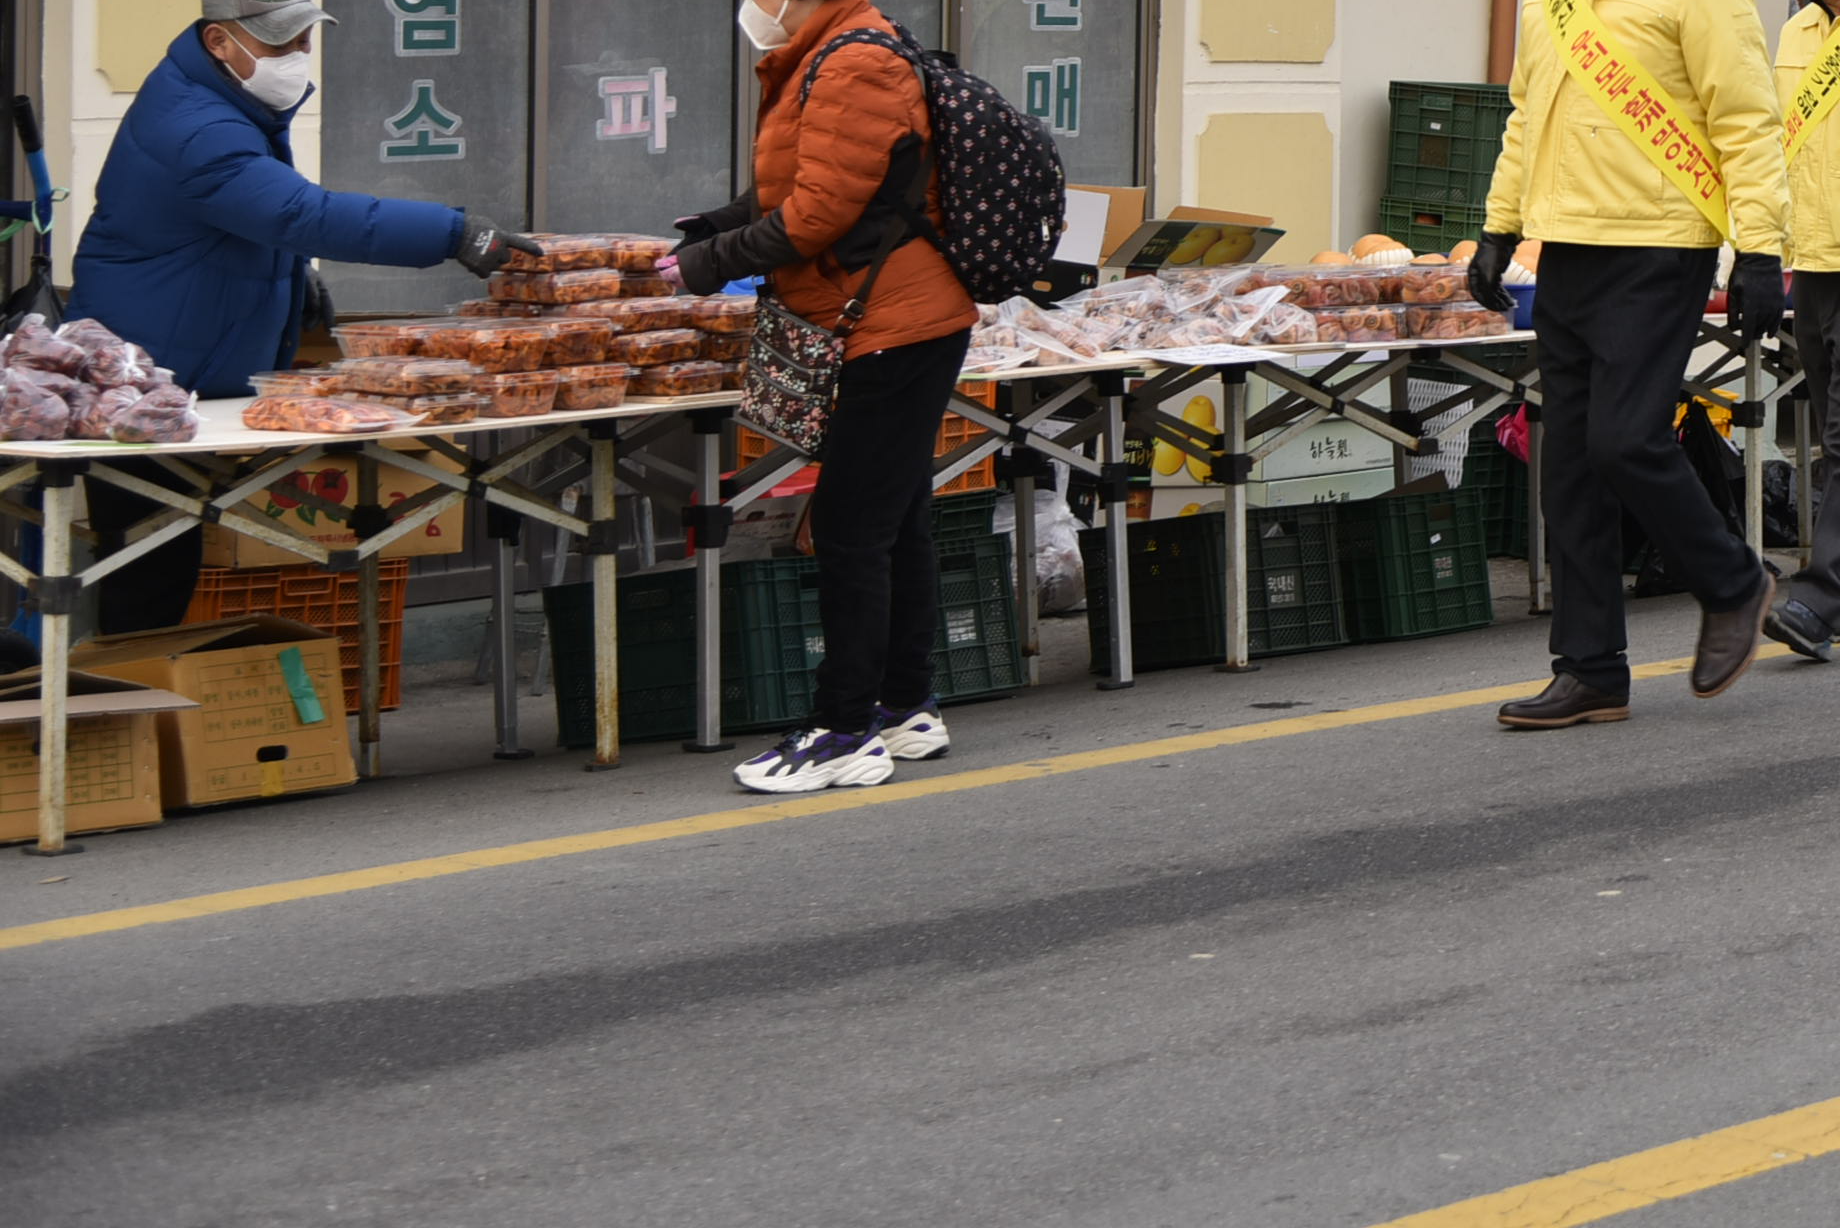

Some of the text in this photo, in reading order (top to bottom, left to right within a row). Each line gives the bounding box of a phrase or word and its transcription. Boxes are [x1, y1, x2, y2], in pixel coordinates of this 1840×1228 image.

[1570, 29, 1609, 70] 우리
[1594, 59, 1636, 101] 모두
[1621, 88, 1667, 132] 함께
[1651, 118, 1727, 199] 막아냅시다
[1796, 87, 1819, 120] 전에
